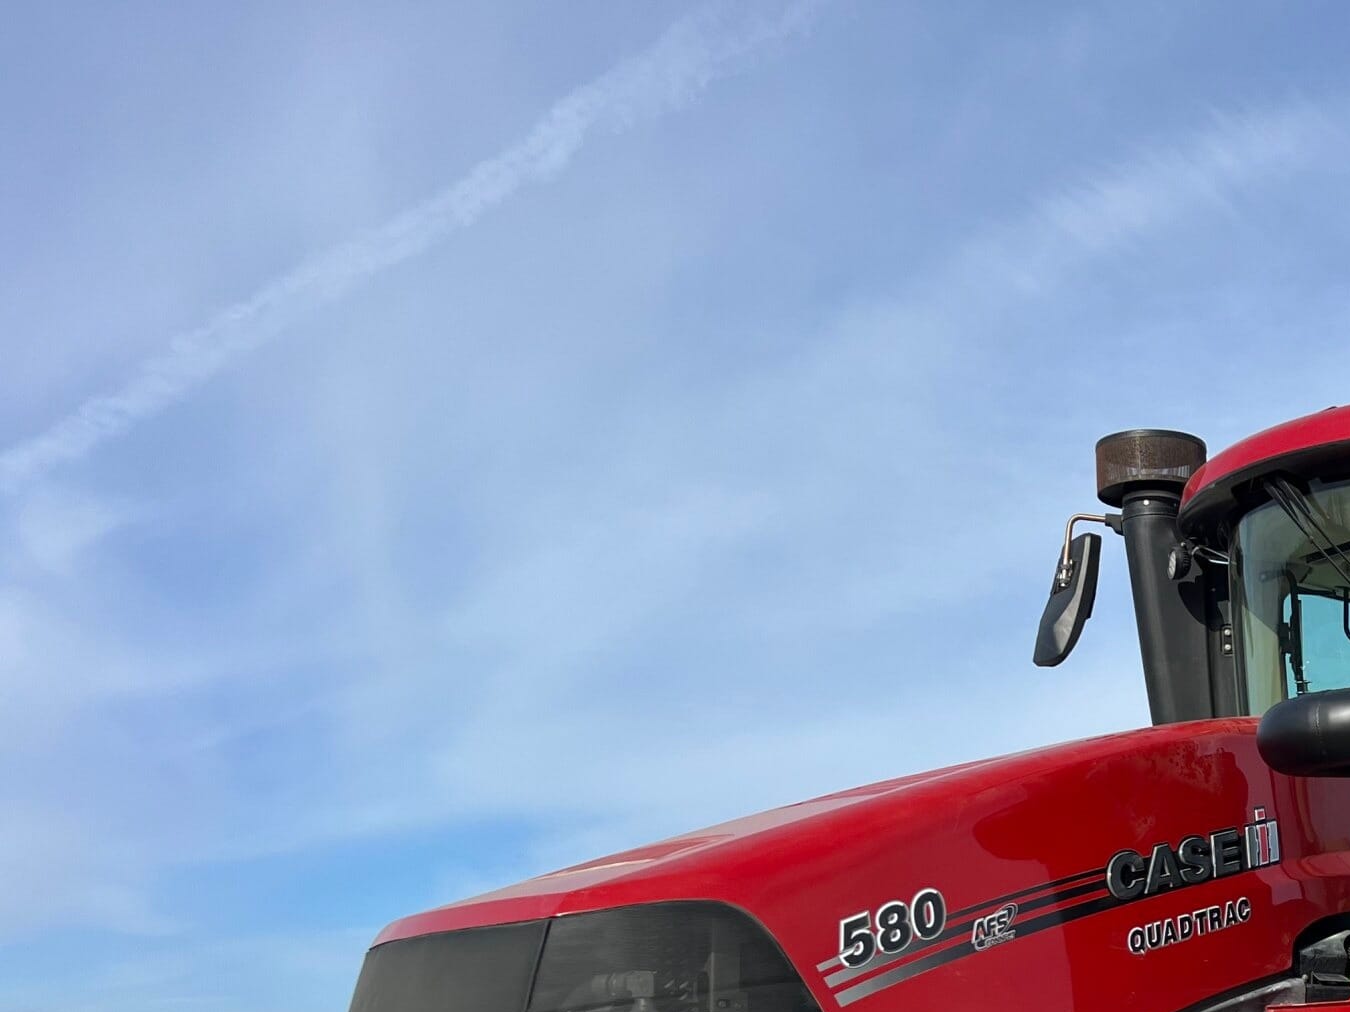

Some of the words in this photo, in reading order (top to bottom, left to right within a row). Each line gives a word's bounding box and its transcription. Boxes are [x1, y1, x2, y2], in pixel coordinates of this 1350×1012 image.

[1106, 829, 1242, 901] CASE
[838, 887, 947, 969] 580
[971, 909, 1010, 944] AFS
[1127, 896, 1251, 955] QUADTRAC
